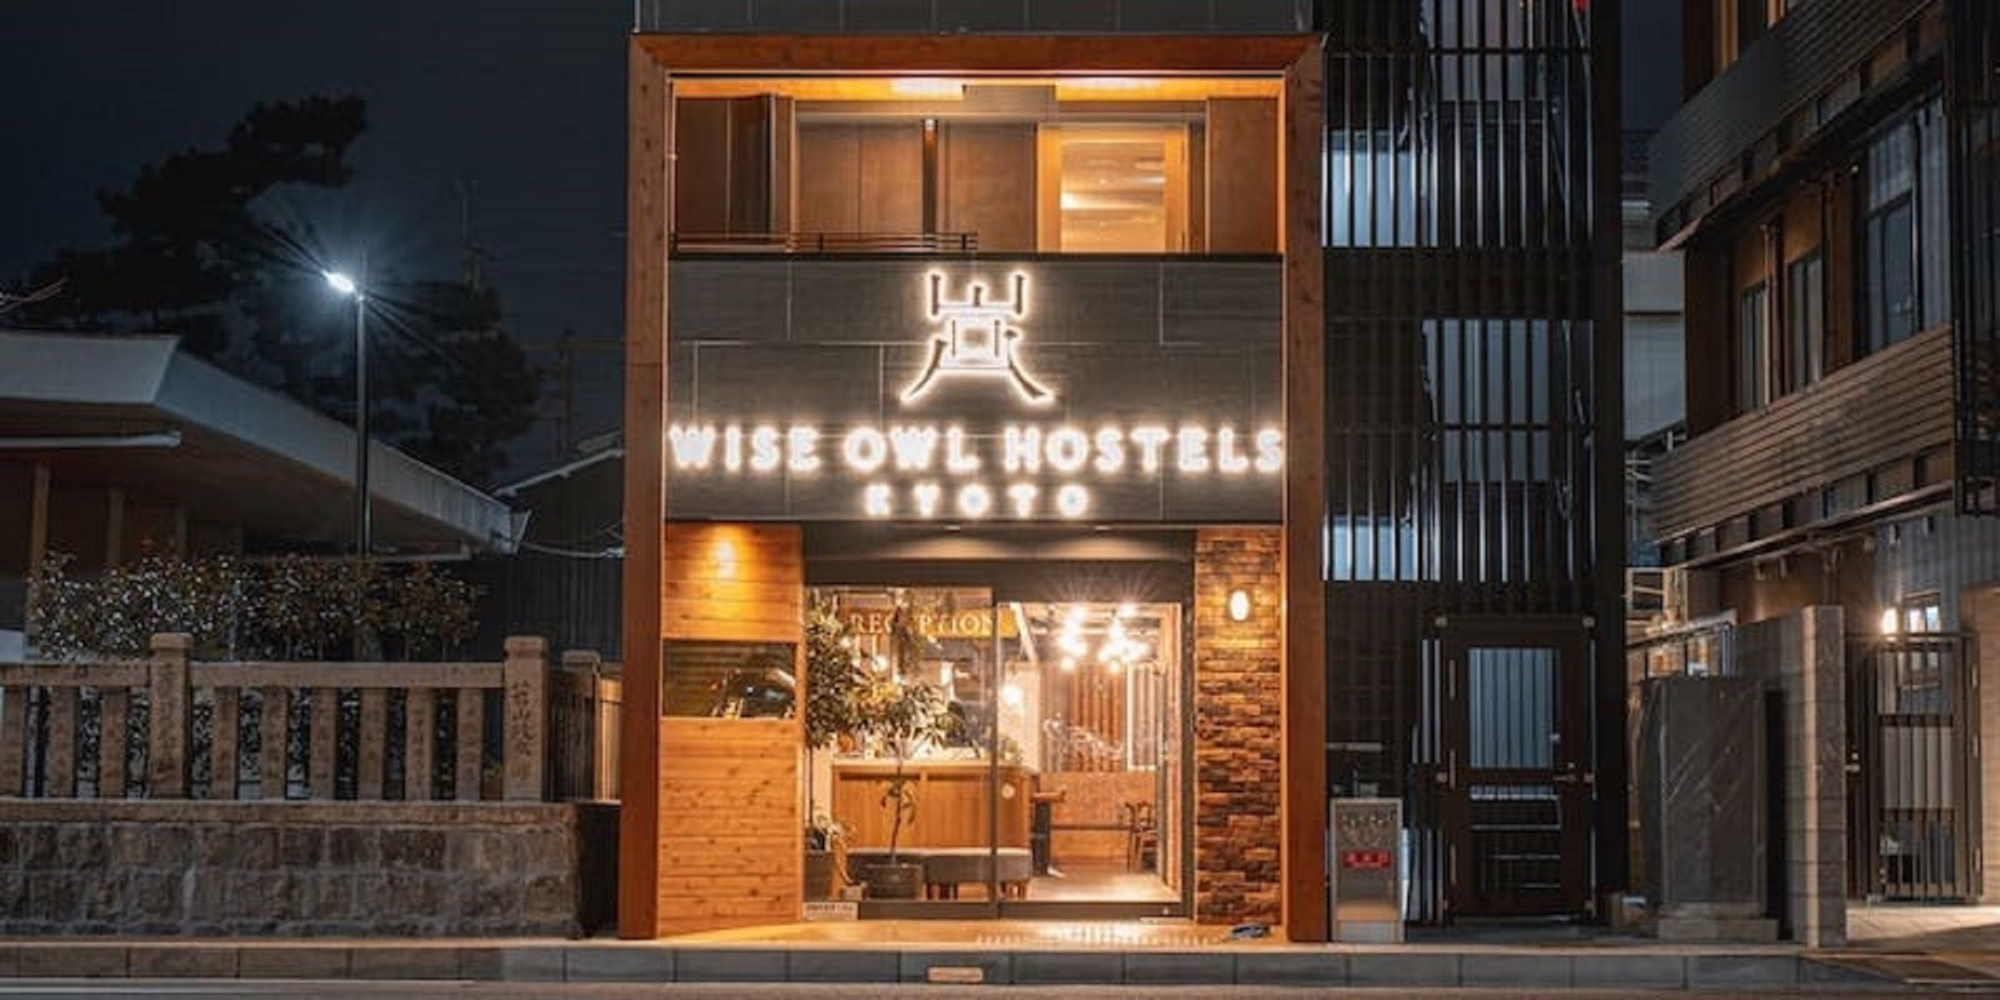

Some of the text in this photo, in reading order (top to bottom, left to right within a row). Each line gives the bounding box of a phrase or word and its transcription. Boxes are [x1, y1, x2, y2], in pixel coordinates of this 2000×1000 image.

[668, 425, 1282, 474] WISE OWL HOSTELS
[865, 483, 1090, 518] KYOTO
[850, 611, 993, 635] RECPTION
